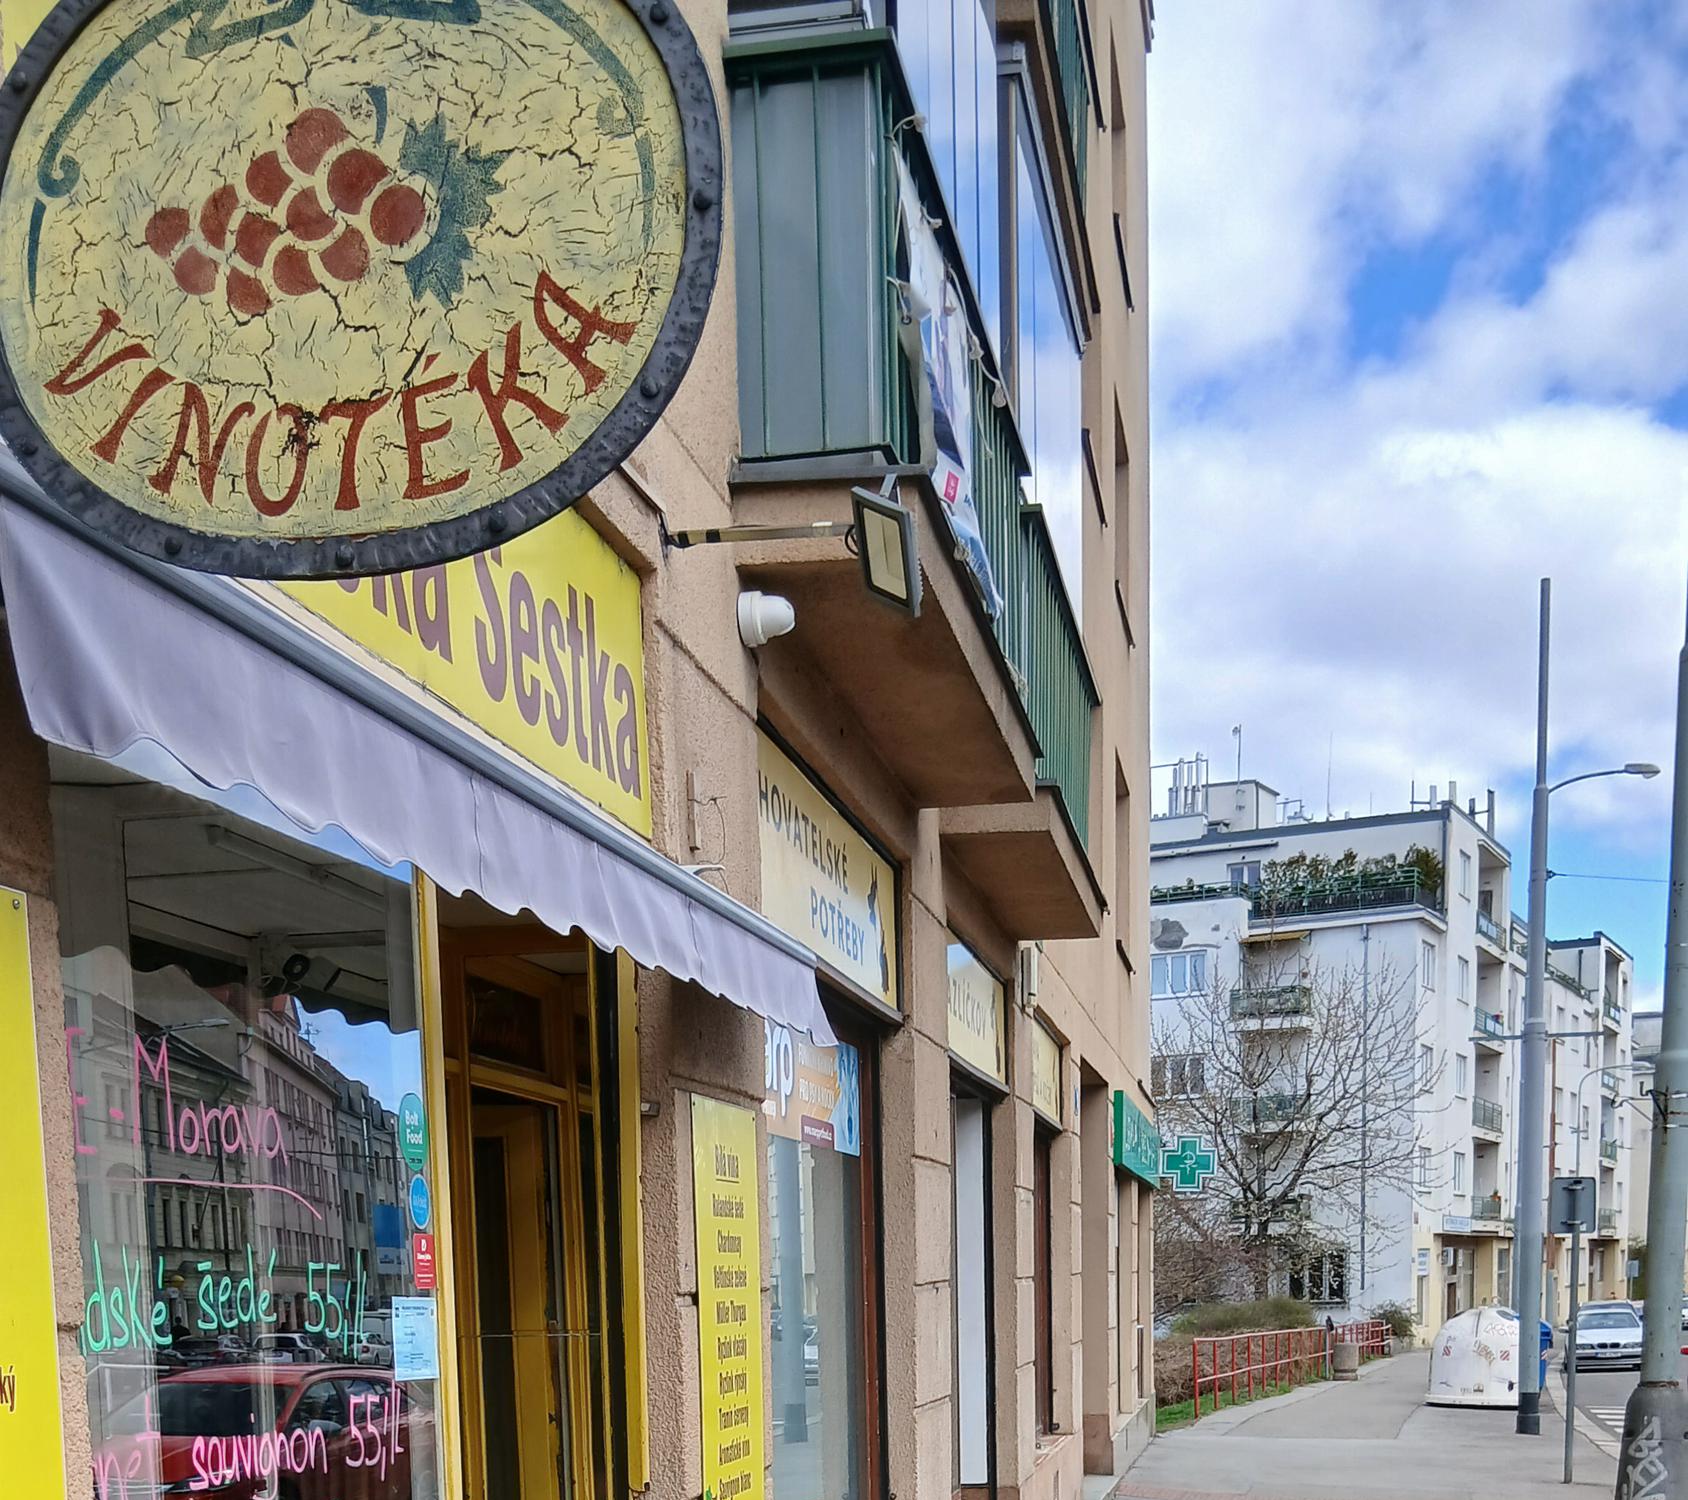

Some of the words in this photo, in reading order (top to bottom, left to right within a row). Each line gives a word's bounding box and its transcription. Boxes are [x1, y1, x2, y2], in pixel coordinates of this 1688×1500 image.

[43, 270, 637, 518] VINOTÉKA
[473, 545, 642, 800] Šestka
[758, 769, 849, 895] HOVATELSKÉ
[810, 886, 865, 966] POTŘEBY
[132, 1033, 288, 1167] Morava
[405, 1110, 419, 1126] Bolt
[406, 1129, 423, 1145] Food
[81, 1239, 172, 1356] dské
[197, 1243, 278, 1330] šedé
